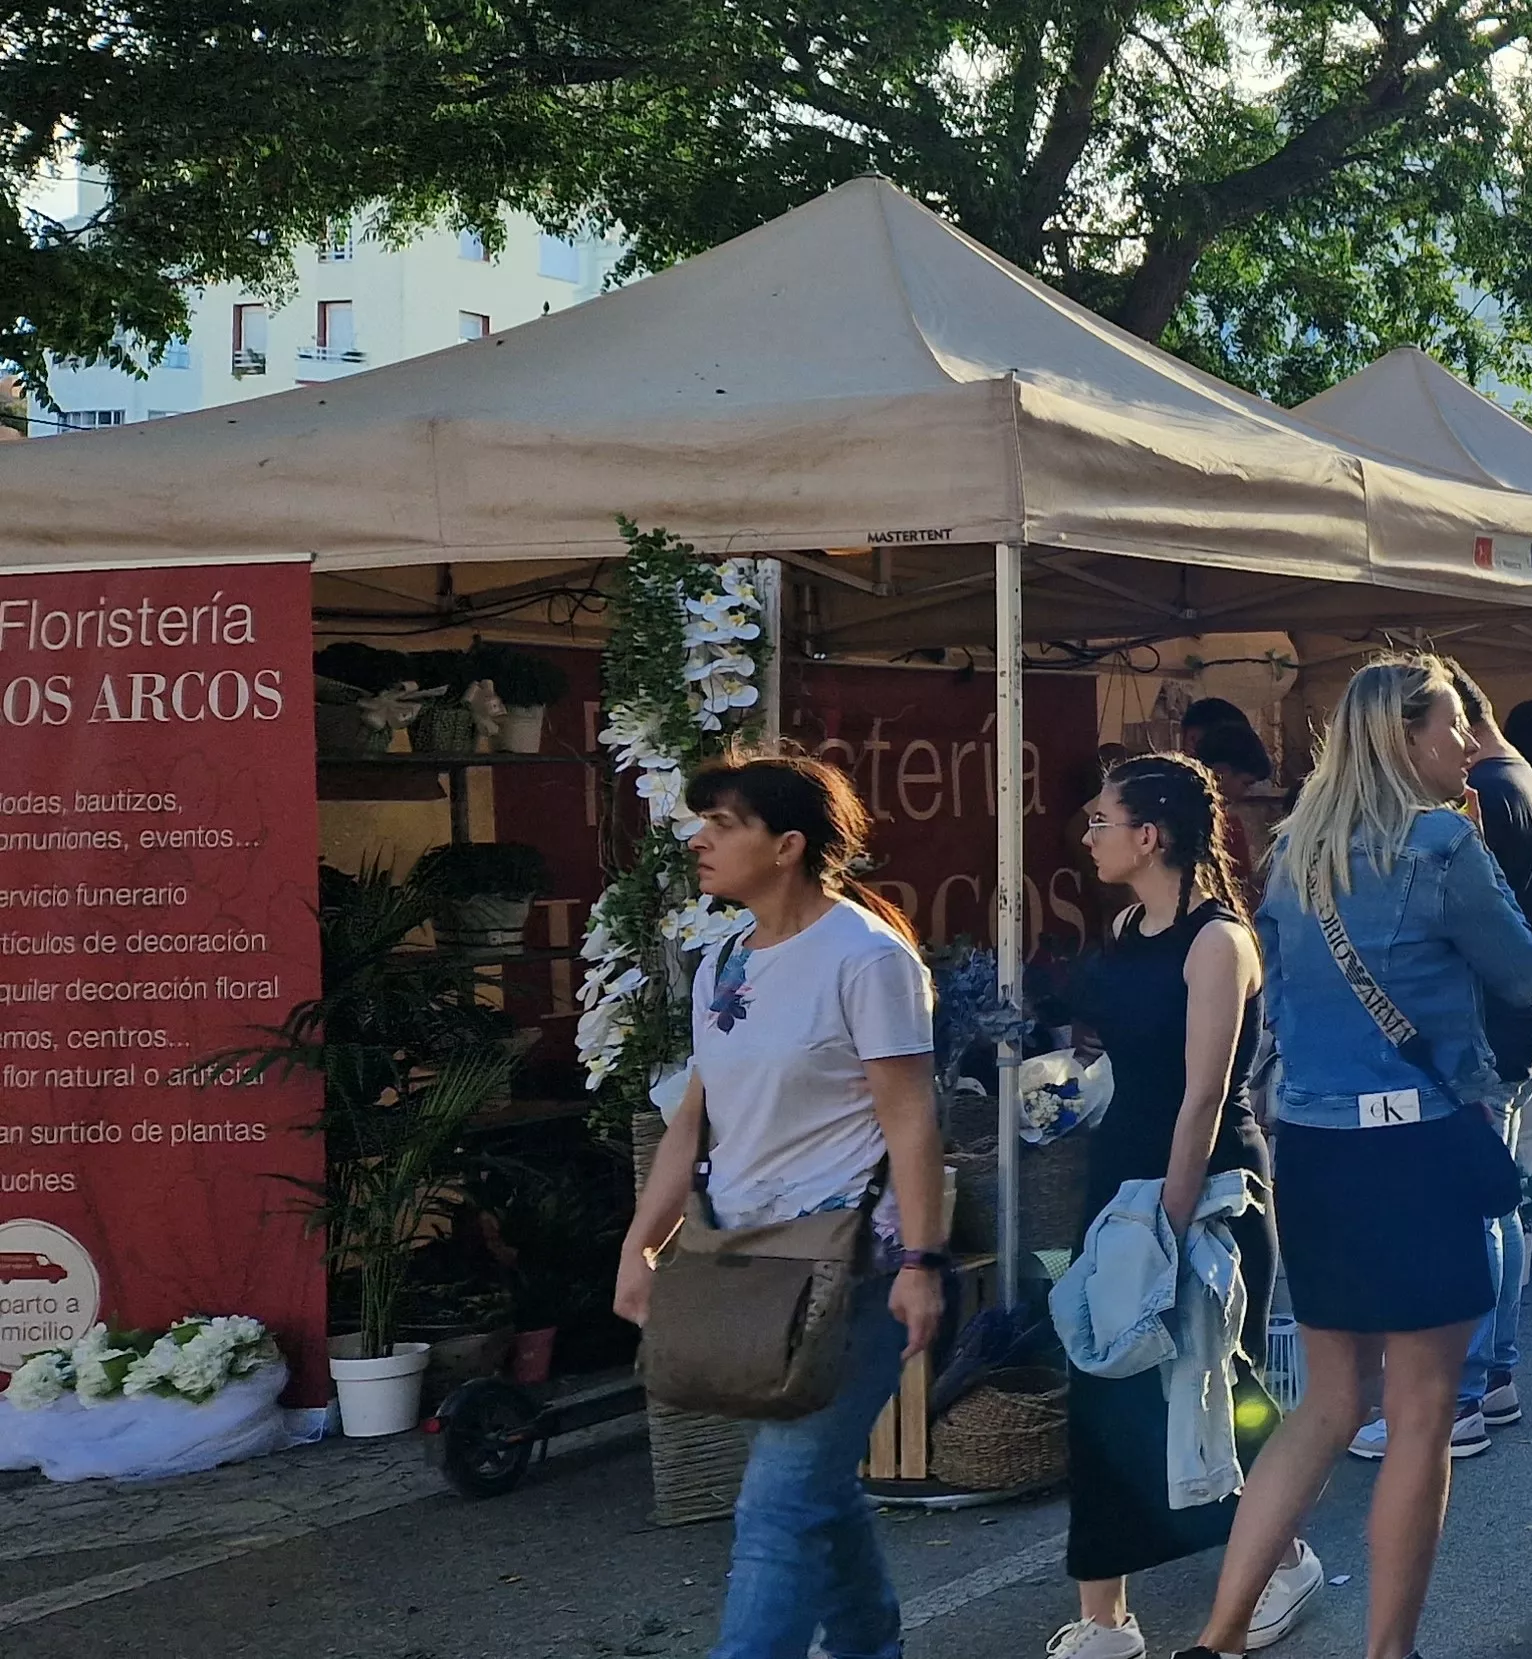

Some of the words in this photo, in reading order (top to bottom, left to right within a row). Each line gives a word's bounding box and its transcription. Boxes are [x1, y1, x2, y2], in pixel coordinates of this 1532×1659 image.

[867, 528, 953, 543] MASTERTENT
[0, 591, 256, 650] Floristería
[0, 674, 72, 727] OS
[87, 669, 283, 724] ARCOS
[0, 790, 67, 816] odas,
[74, 788, 184, 814] bautizos,
[139, 825, 260, 848] eventos...
[76, 881, 188, 907] funerario
[83, 930, 117, 954] de
[126, 928, 267, 953] decoración
[65, 976, 207, 1001] decoración
[215, 974, 280, 1000] floral
[0, 1030, 58, 1051] mos,
[67, 1026, 190, 1048] centros...
[3, 1063, 39, 1088] flor
[44, 1063, 135, 1088] natural
[143, 1067, 160, 1087] o
[30, 1120, 122, 1145] surtido
[131, 1120, 163, 1143] de
[171, 1118, 267, 1147] plantas
[0, 1168, 77, 1192] uches
[66, 1297, 80, 1314] a
[2, 1320, 73, 1341] micilio
